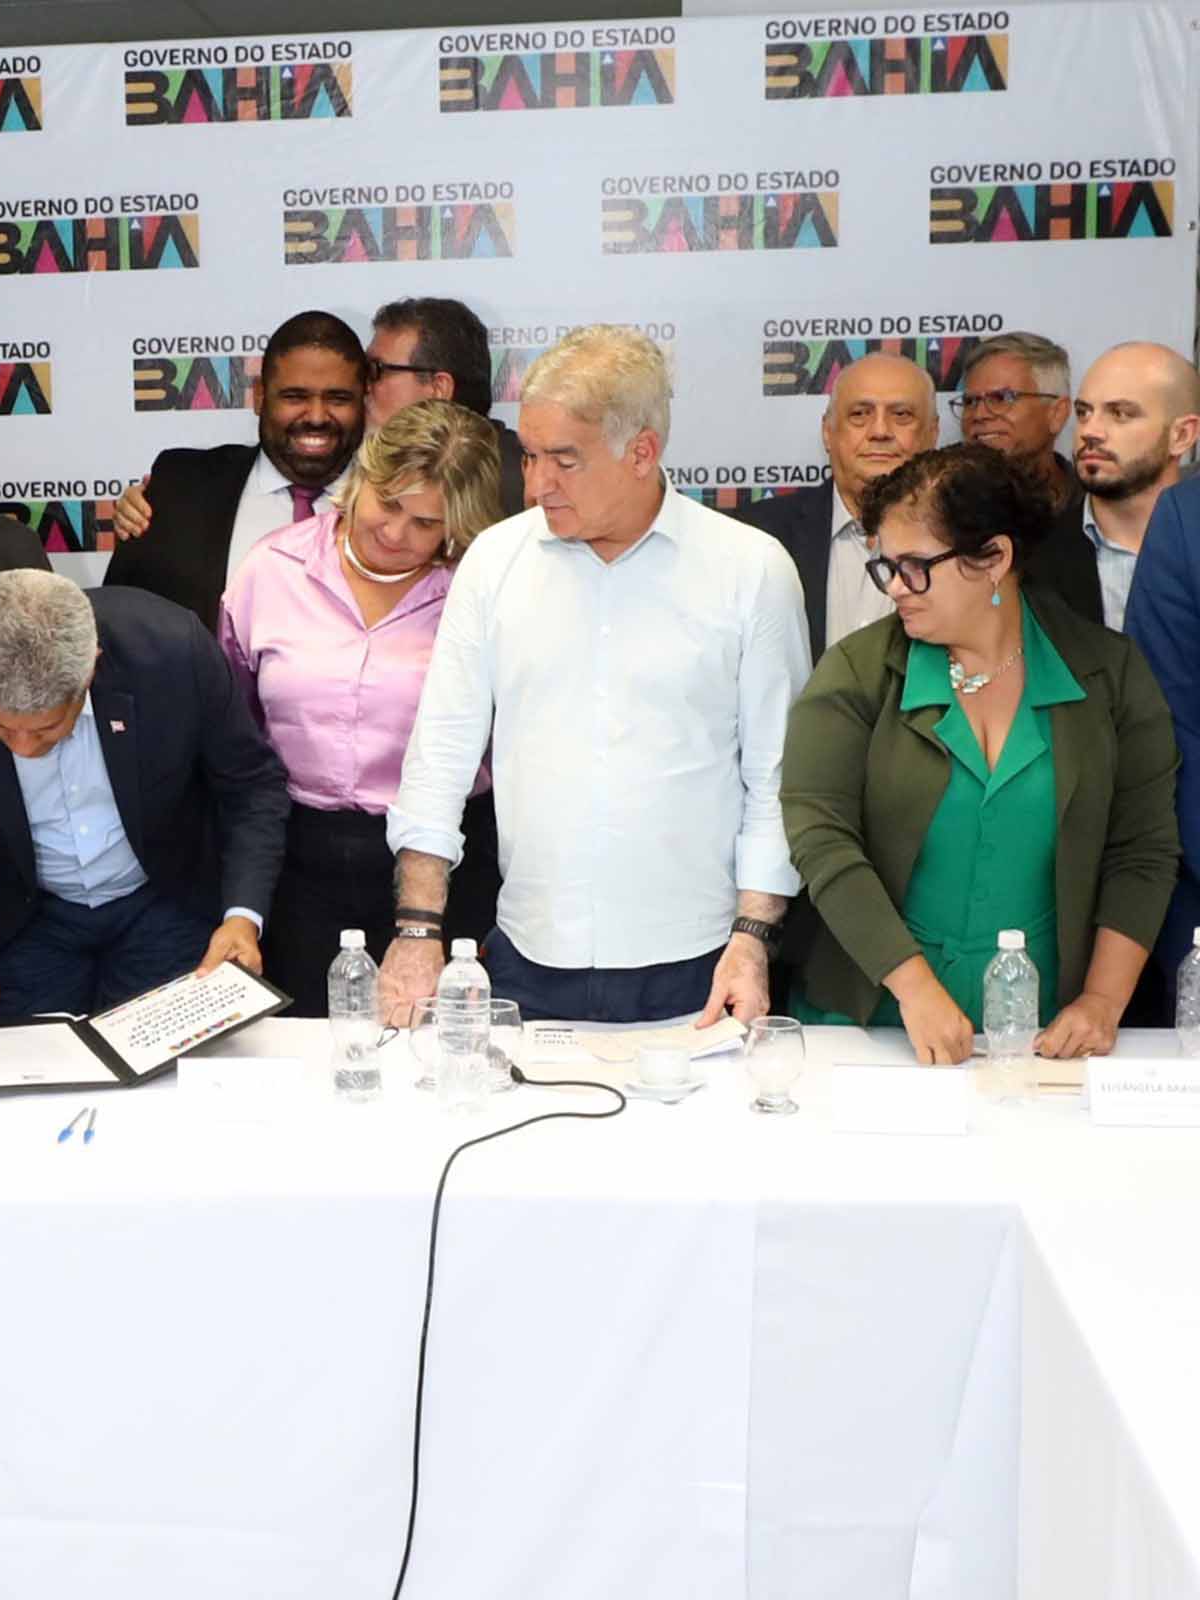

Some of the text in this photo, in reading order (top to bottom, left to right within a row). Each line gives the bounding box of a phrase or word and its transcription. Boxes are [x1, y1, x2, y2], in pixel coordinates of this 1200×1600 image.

[766, 11, 1009, 39] GOVERNO DO ESTADO
[439, 26, 675, 53] GOVERNO DO ESTADO
[124, 41, 352, 68] GOVERNO DO ESTADO
[765, 34, 1008, 100] BAHIA
[124, 63, 352, 126] BAHIA
[439, 49, 674, 113] BAHIA
[602, 169, 840, 195] GOVERNO DO ESTADO
[929, 158, 1176, 184] GOVERNO DO ESTADO
[84, 196, 114, 215] DO
[120, 193, 199, 213] ESTADO
[283, 182, 514, 208] GOVERNO DO ESTADO
[602, 192, 839, 254] BAHIA
[929, 181, 1175, 244] BAHIA
[283, 203, 513, 266] BAHIA
[763, 313, 1004, 338] GOVERNO DO ESTADO
[132, 334, 269, 356] GOVERNO DO
[93, 479, 122, 496] DO
[716, 466, 746, 484] DO
